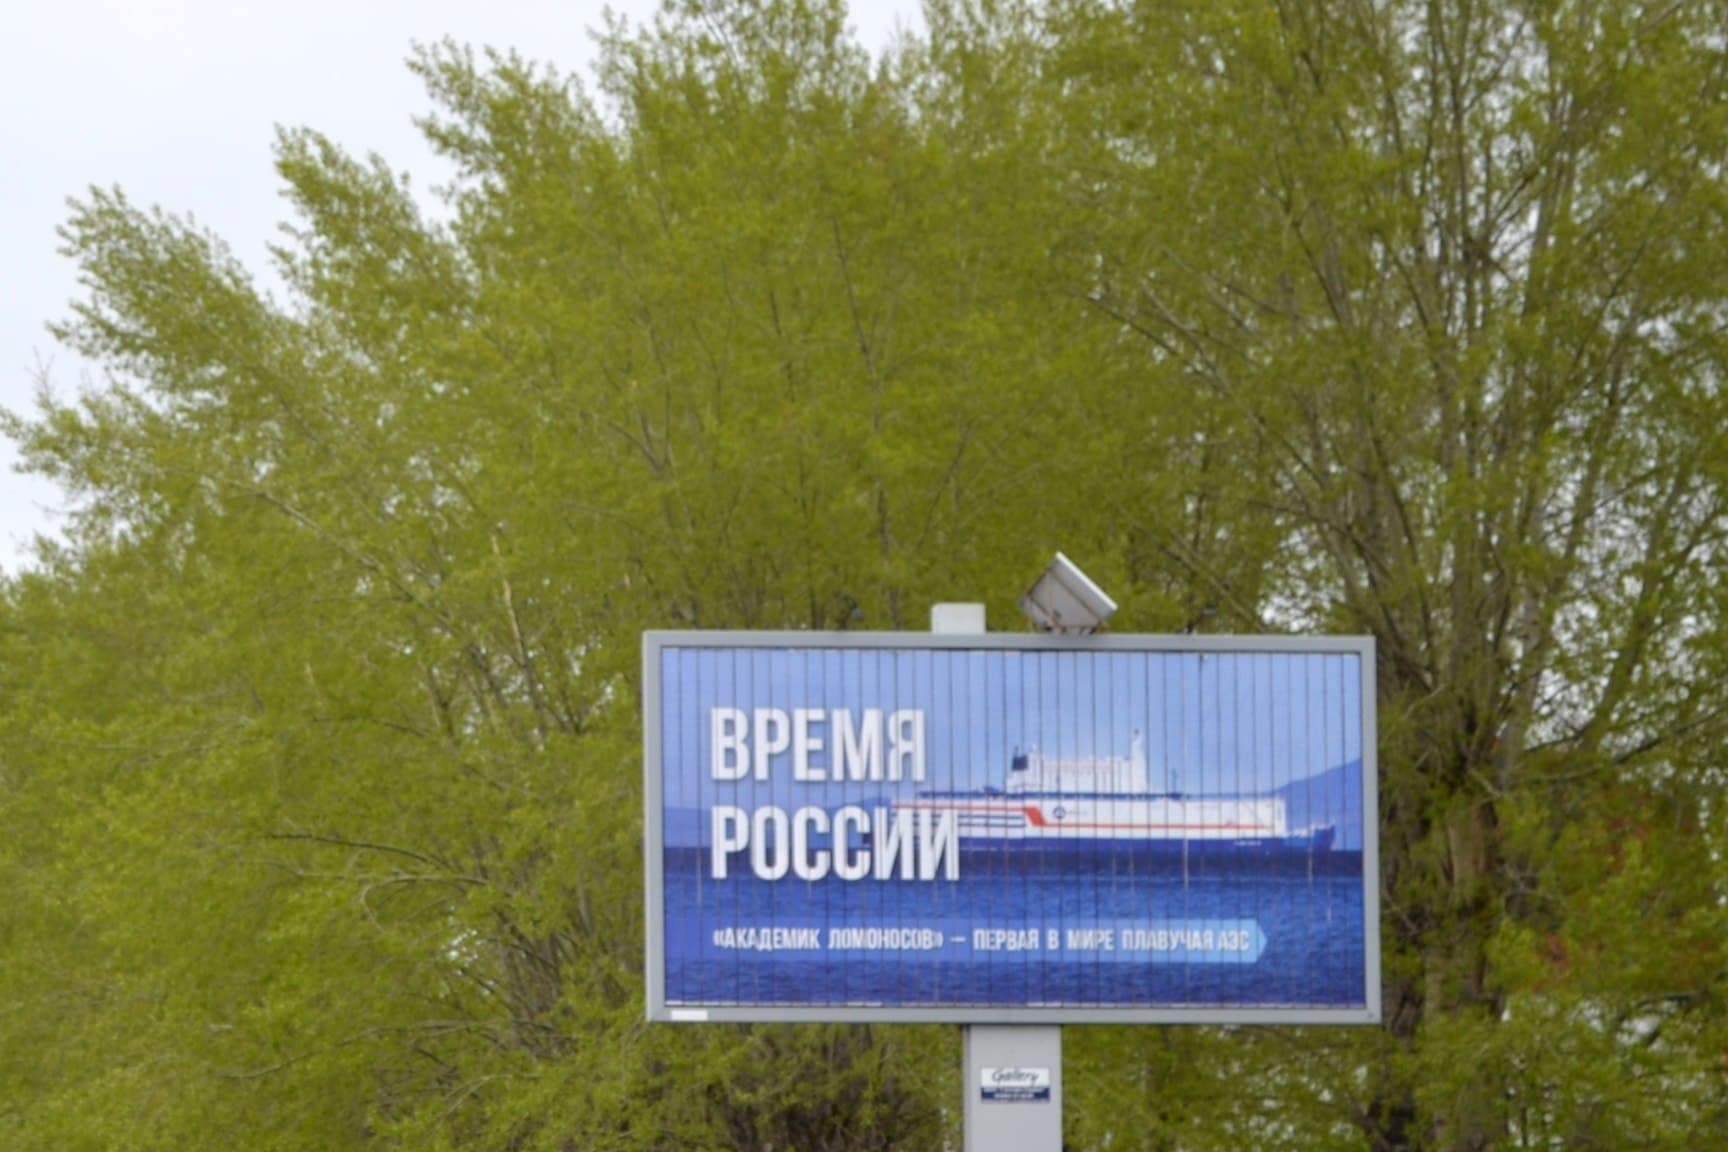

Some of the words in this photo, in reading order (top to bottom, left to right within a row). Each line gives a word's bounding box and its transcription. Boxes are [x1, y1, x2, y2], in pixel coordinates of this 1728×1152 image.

[710, 707, 926, 782] ВРЕМЯ
[710, 805, 960, 881] РОССИИ
[713, 927, 821, 951] «АКАДЕМИК
[828, 928, 943, 951] ЛОМОНОСОВ»
[973, 928, 1039, 951] ПЕРВАЯ
[1047, 929, 1060, 951] В
[1067, 929, 1115, 951] МИРЕ
[1122, 929, 1213, 952] ПЛАВУЧАЯ
